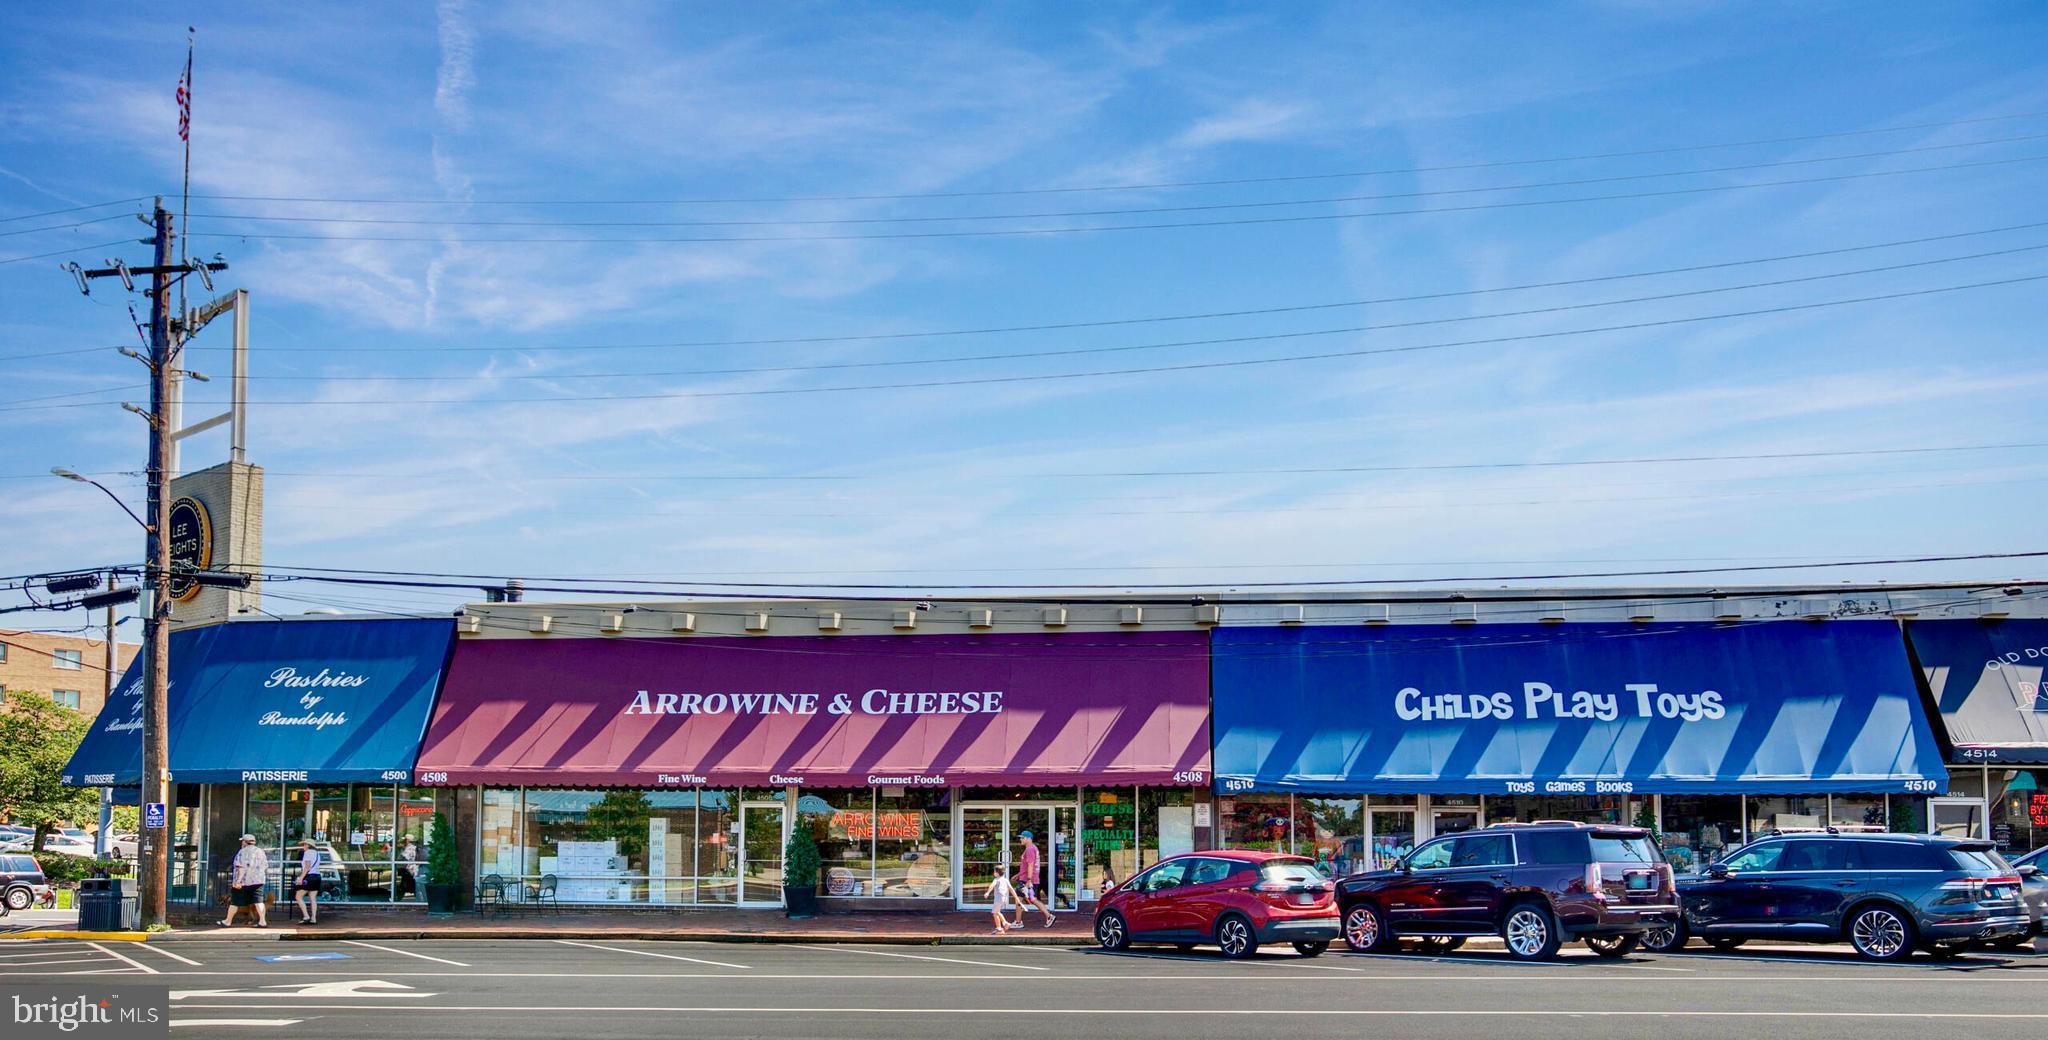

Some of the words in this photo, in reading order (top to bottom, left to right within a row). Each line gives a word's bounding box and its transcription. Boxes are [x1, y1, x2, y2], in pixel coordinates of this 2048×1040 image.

[172, 523, 188, 538] LEE
[170, 538, 197, 556] EIGHTS
[1986, 652, 2020, 671] OLD
[264, 667, 370, 688] Pastries
[300, 691, 325, 710] by
[624, 690, 819, 715] ARROWINE
[827, 691, 854, 715] &
[860, 688, 1004, 714] CHEESE
[258, 711, 349, 731] Randolph
[1963, 750, 1998, 758] 4514
[242, 770, 308, 781] PATISSERIE
[381, 770, 408, 781] 4500
[421, 772, 448, 783] 4508
[658, 774, 680, 784] Fine
[681, 774, 707, 784] Wine
[769, 774, 804, 784] Cheese
[867, 774, 911, 785] Gourmet
[914, 774, 945, 785] Foods
[1173, 771, 1203, 783] 4508
[1226, 780, 1255, 791] 4510
[1904, 780, 1937, 791] 4510
[1083, 804, 1134, 814] CHEESE
[847, 826, 874, 838] FINE
[877, 826, 920, 838] WINES
[1081, 829, 1135, 840] SPECIALTY
